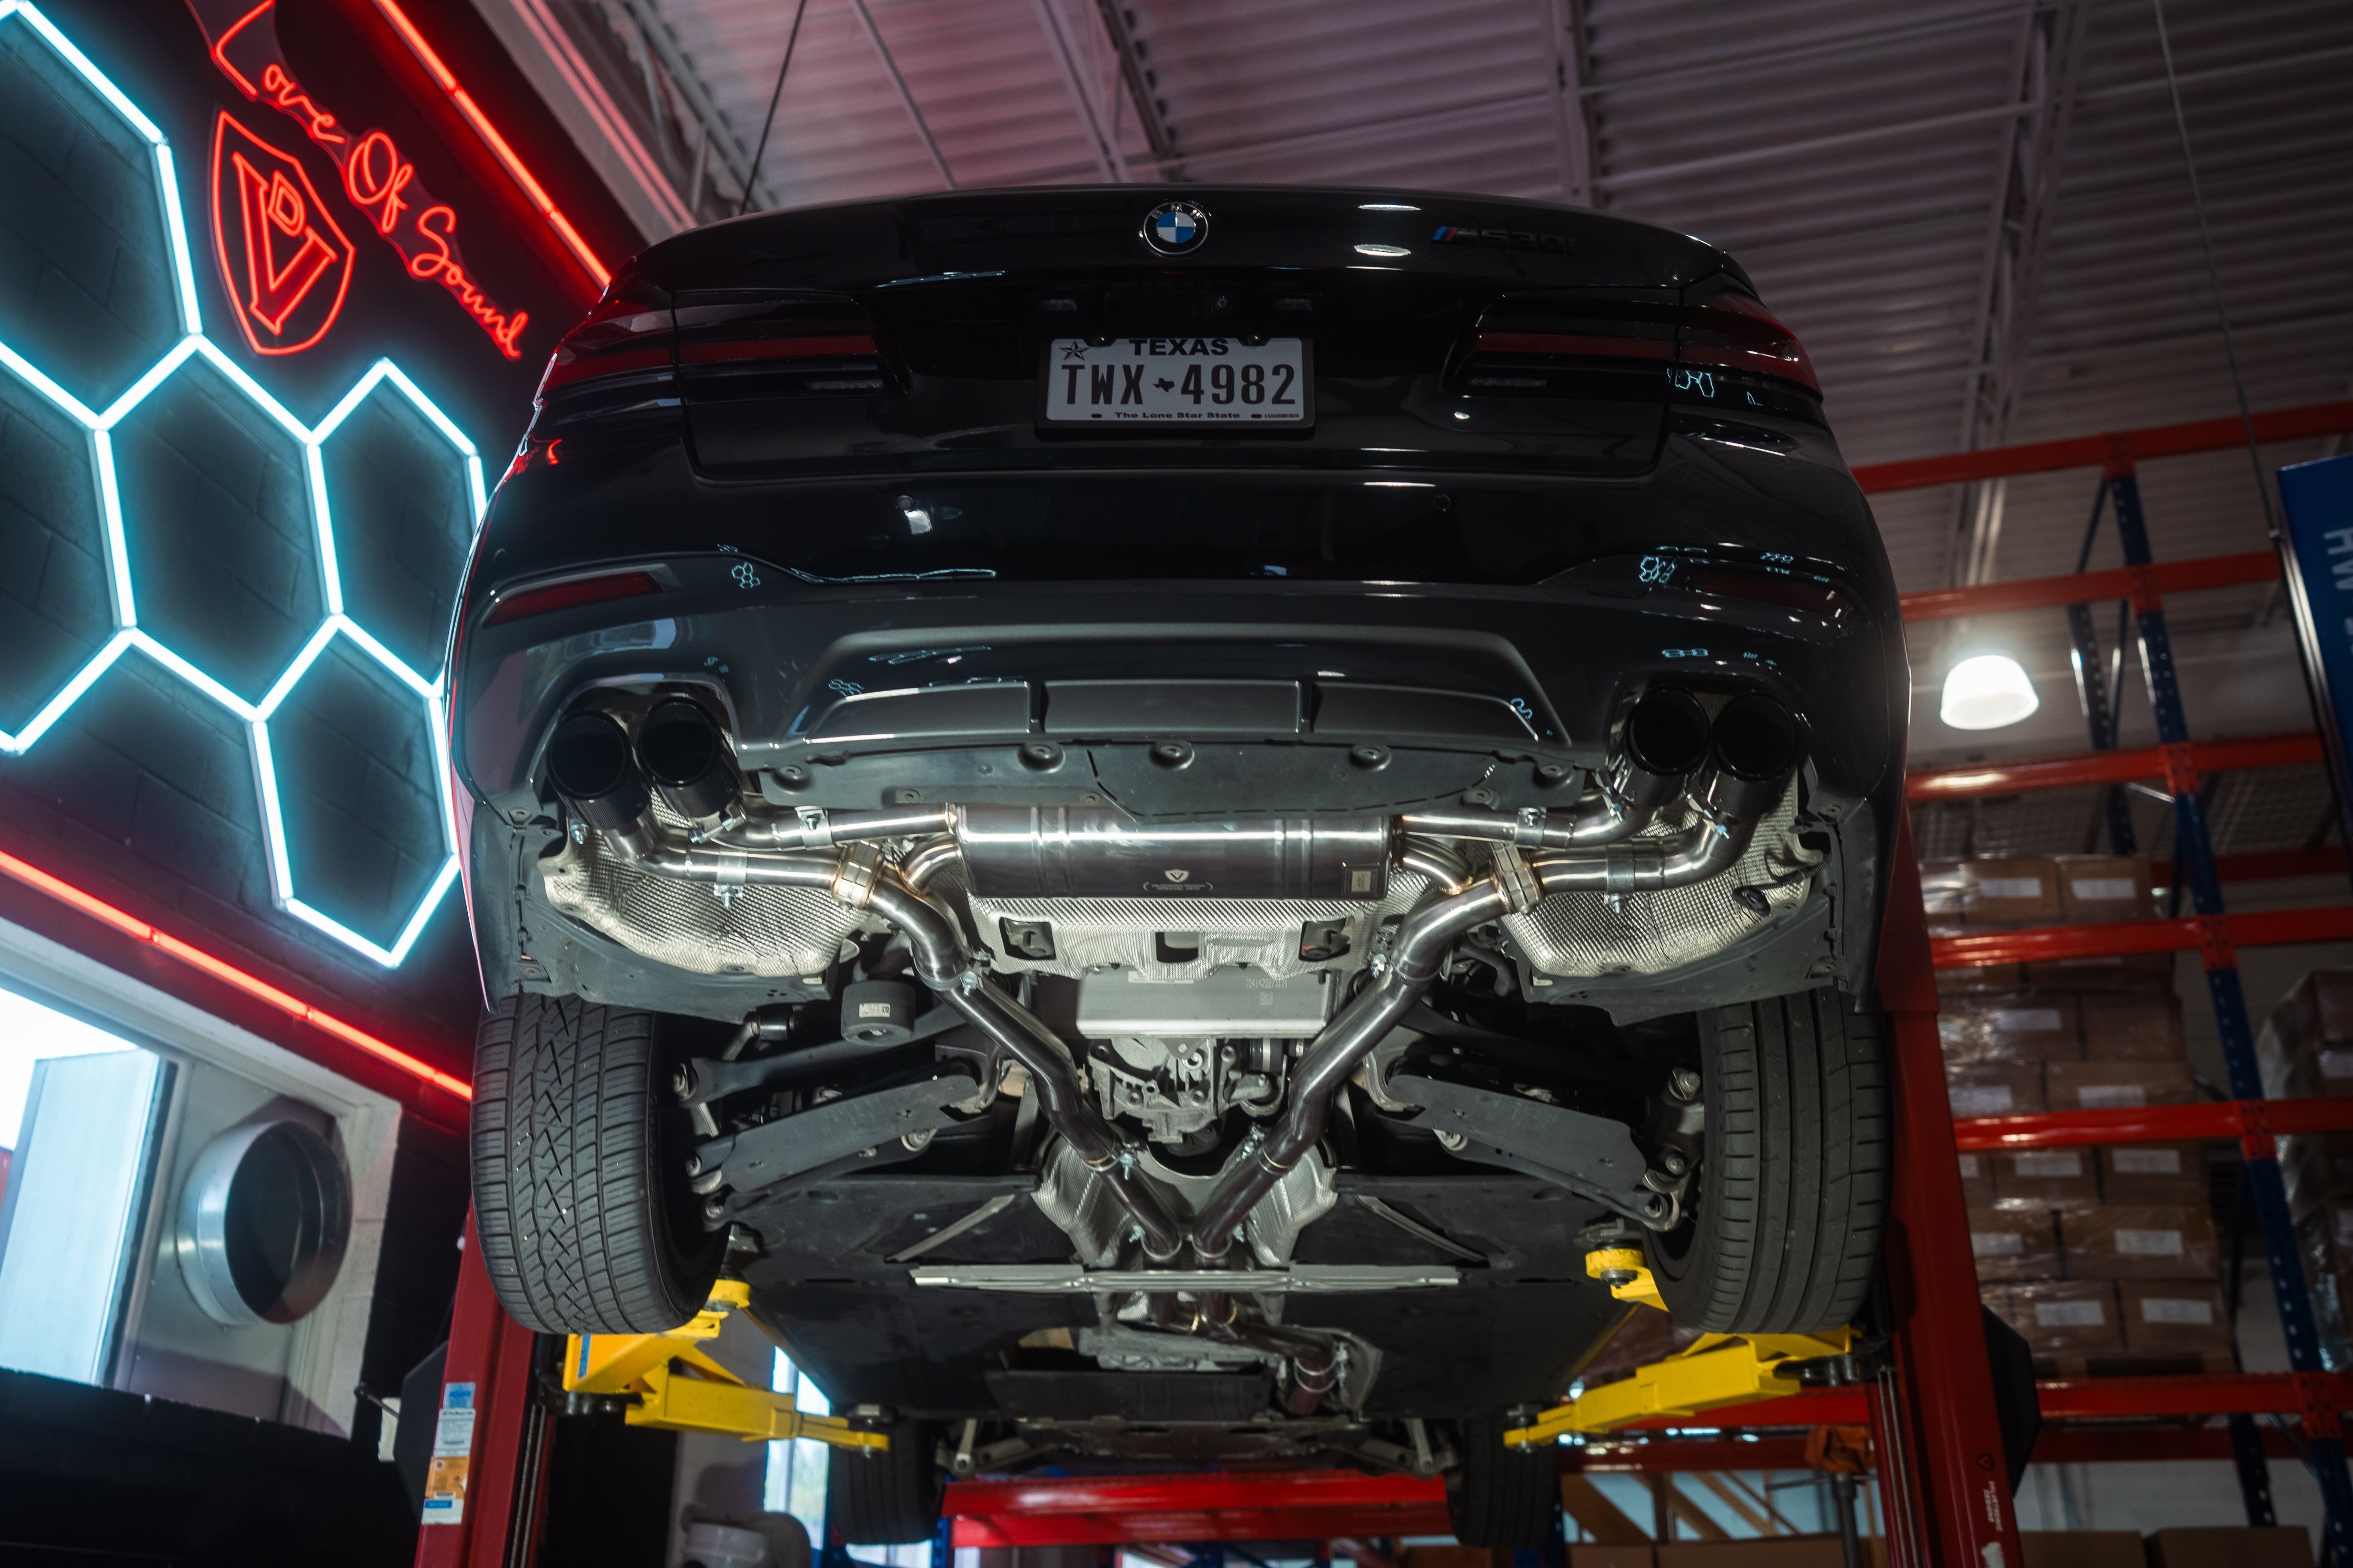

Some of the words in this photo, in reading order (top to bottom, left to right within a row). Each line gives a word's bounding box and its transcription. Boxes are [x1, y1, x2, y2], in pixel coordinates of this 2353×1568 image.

[214, 0, 346, 144] Love
[348, 131, 415, 234] Of
[411, 205, 529, 360] Sound
[1129, 338, 1229, 356] TEXAS
[1061, 364, 1145, 405] TWX
[1180, 364, 1296, 405] 4982
